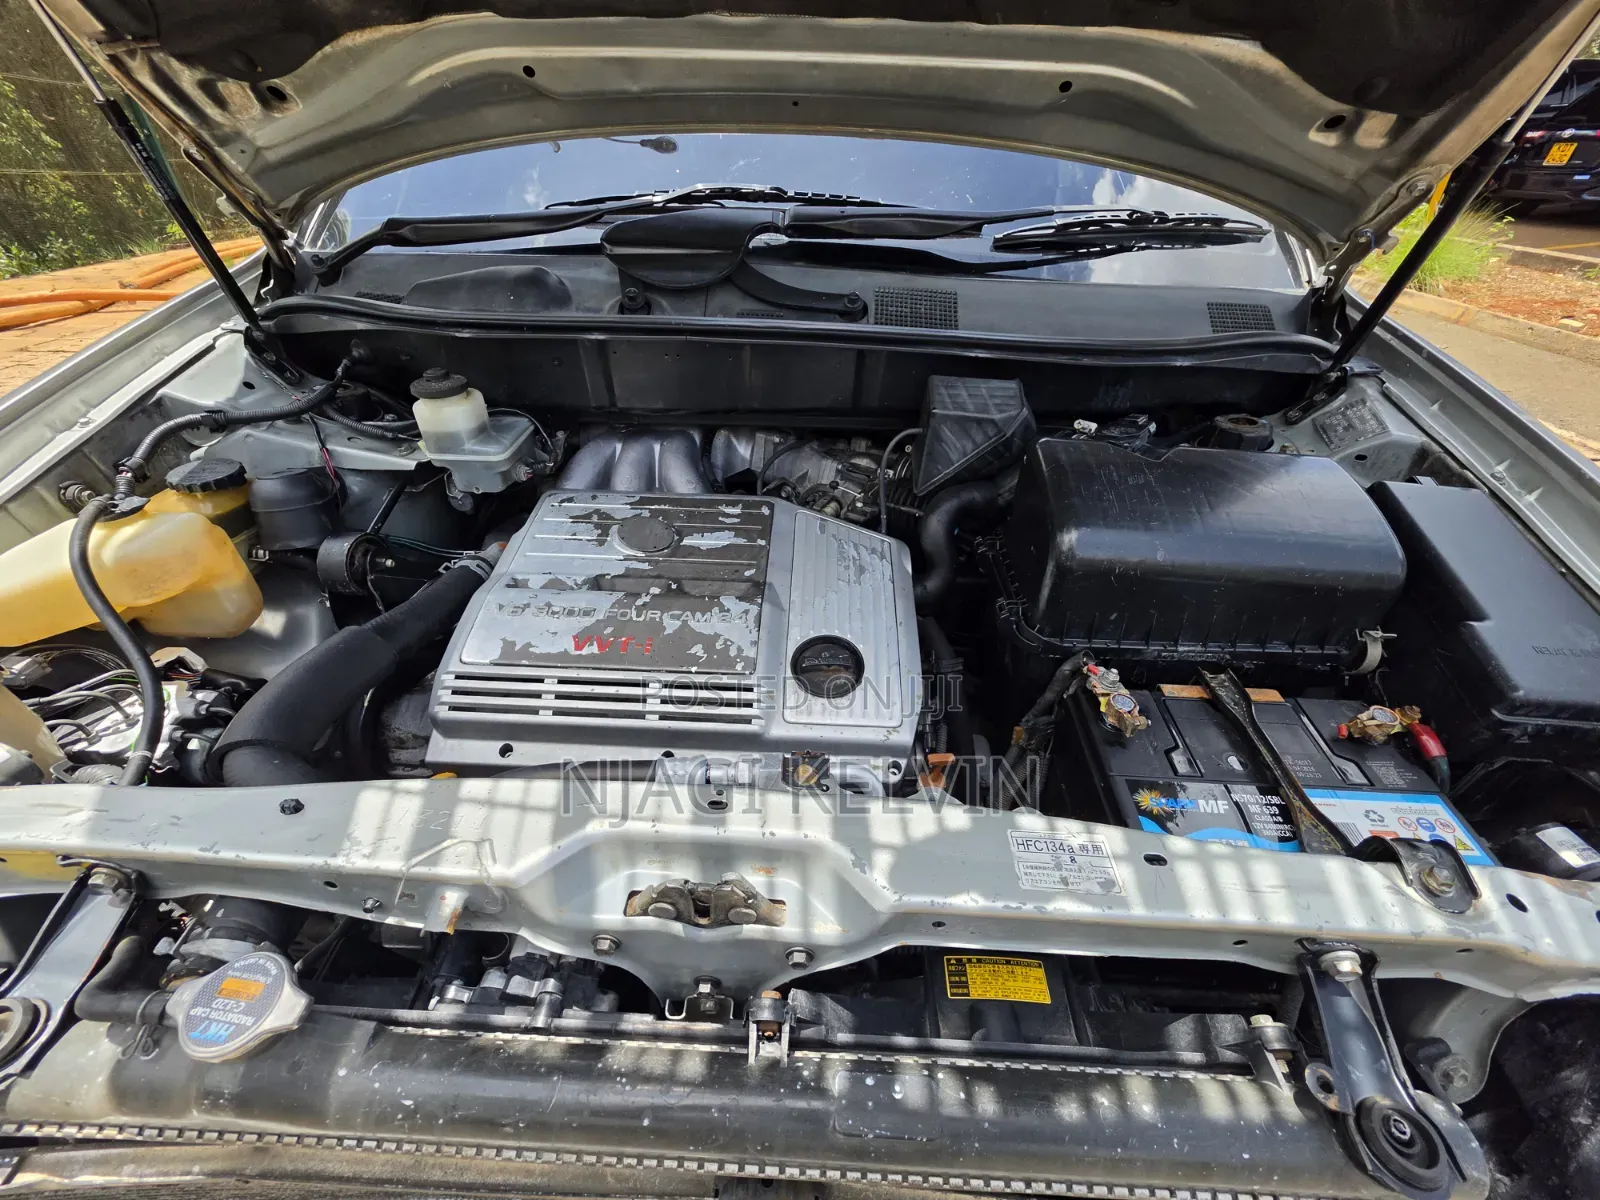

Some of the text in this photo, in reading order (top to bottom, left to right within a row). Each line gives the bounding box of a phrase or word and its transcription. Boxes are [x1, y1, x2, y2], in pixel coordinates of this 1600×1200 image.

[531, 603, 598, 618] 3000
[604, 608, 661, 621] FOUR
[667, 610, 712, 623] CAM
[1198, 799, 1229, 814] MF
[1248, 804, 1280, 815] MF 639
[1015, 839, 1105, 855] HFC134a 専用
[211, 997, 246, 1013] C-12D
[189, 1005, 256, 1027] RADIATOR CAP
